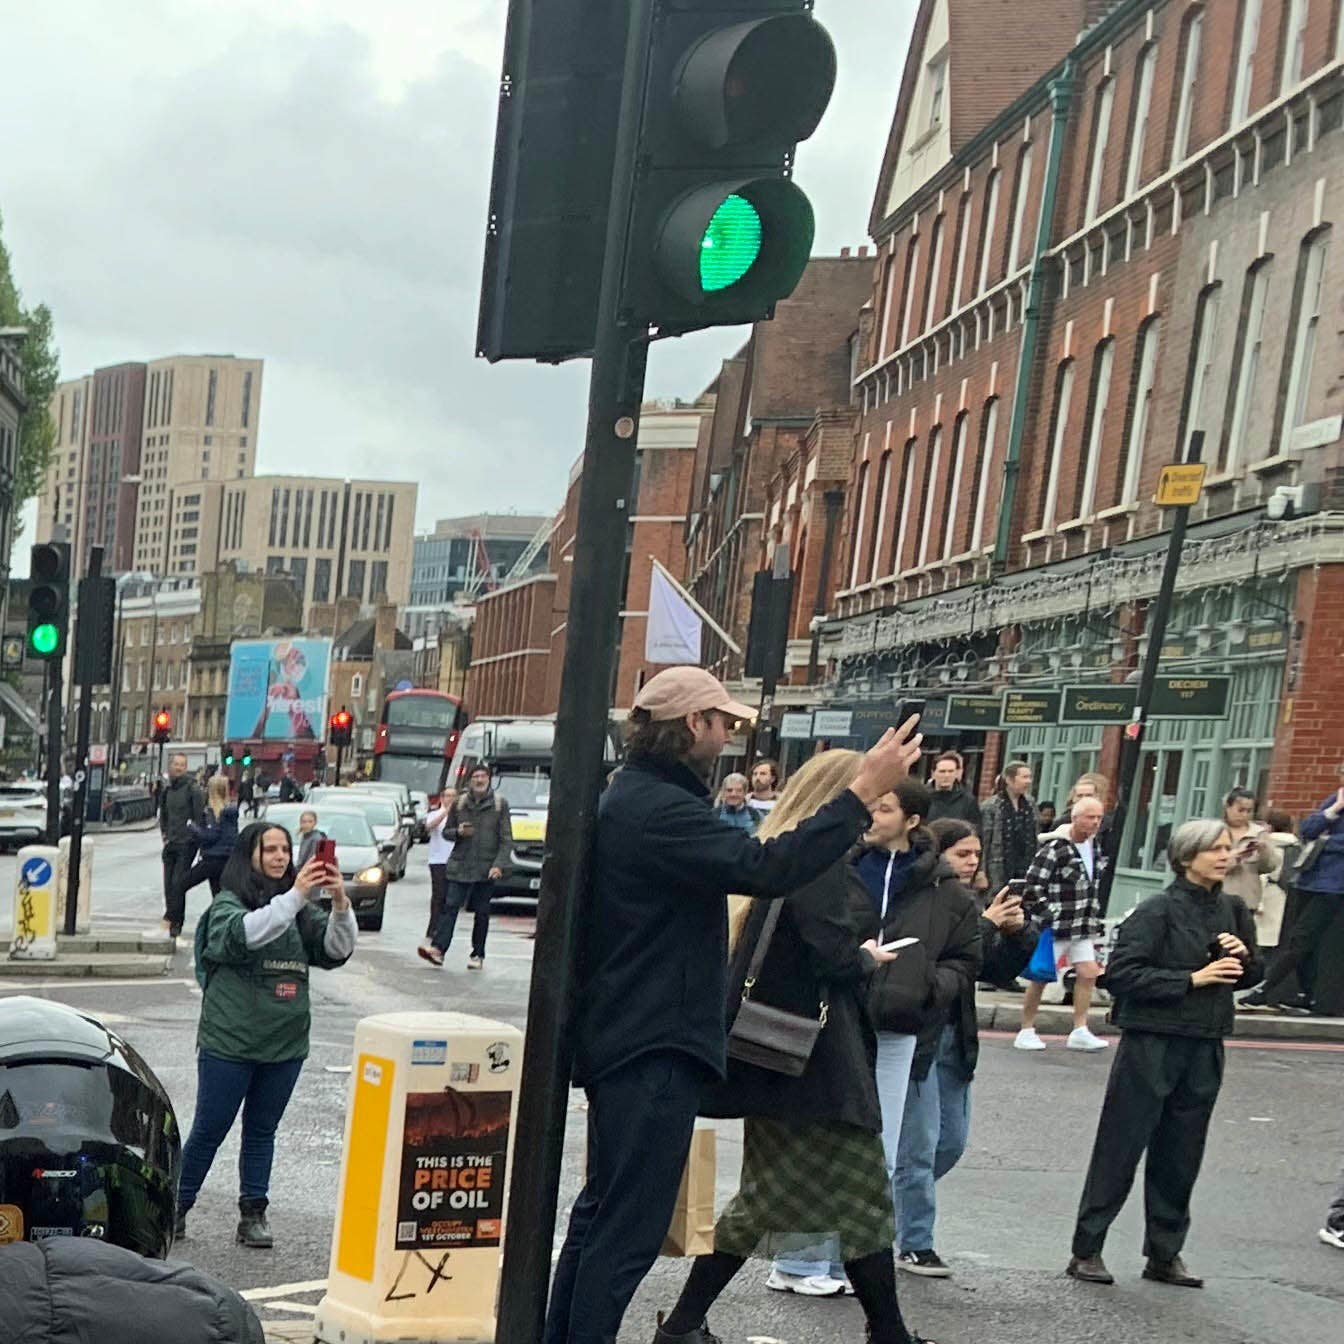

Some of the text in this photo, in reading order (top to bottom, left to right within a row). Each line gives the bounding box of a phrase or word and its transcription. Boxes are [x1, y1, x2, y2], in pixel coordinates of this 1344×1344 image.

[416, 1155, 493, 1168] THIS IS THE
[414, 1168, 492, 1189] PRICE
[412, 1190, 489, 1210] OF OIL
[436, 1233, 472, 1241] OCTOBER
